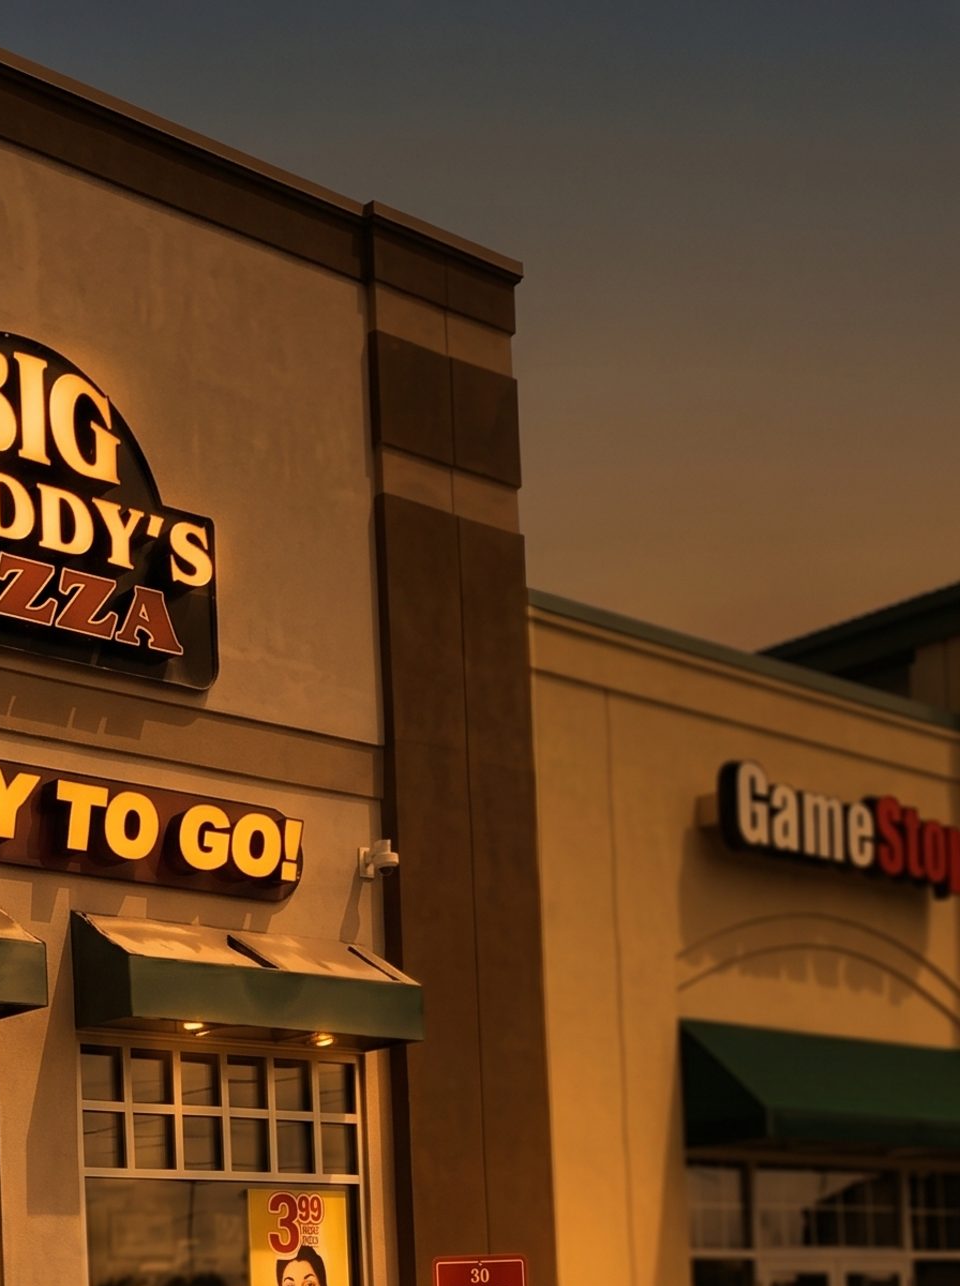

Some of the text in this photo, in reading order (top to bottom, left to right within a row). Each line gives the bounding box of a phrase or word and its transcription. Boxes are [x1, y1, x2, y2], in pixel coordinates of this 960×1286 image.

[56, 780, 161, 861] TO
[178, 804, 304, 882] GO!
[470, 1268, 490, 1283] 30
